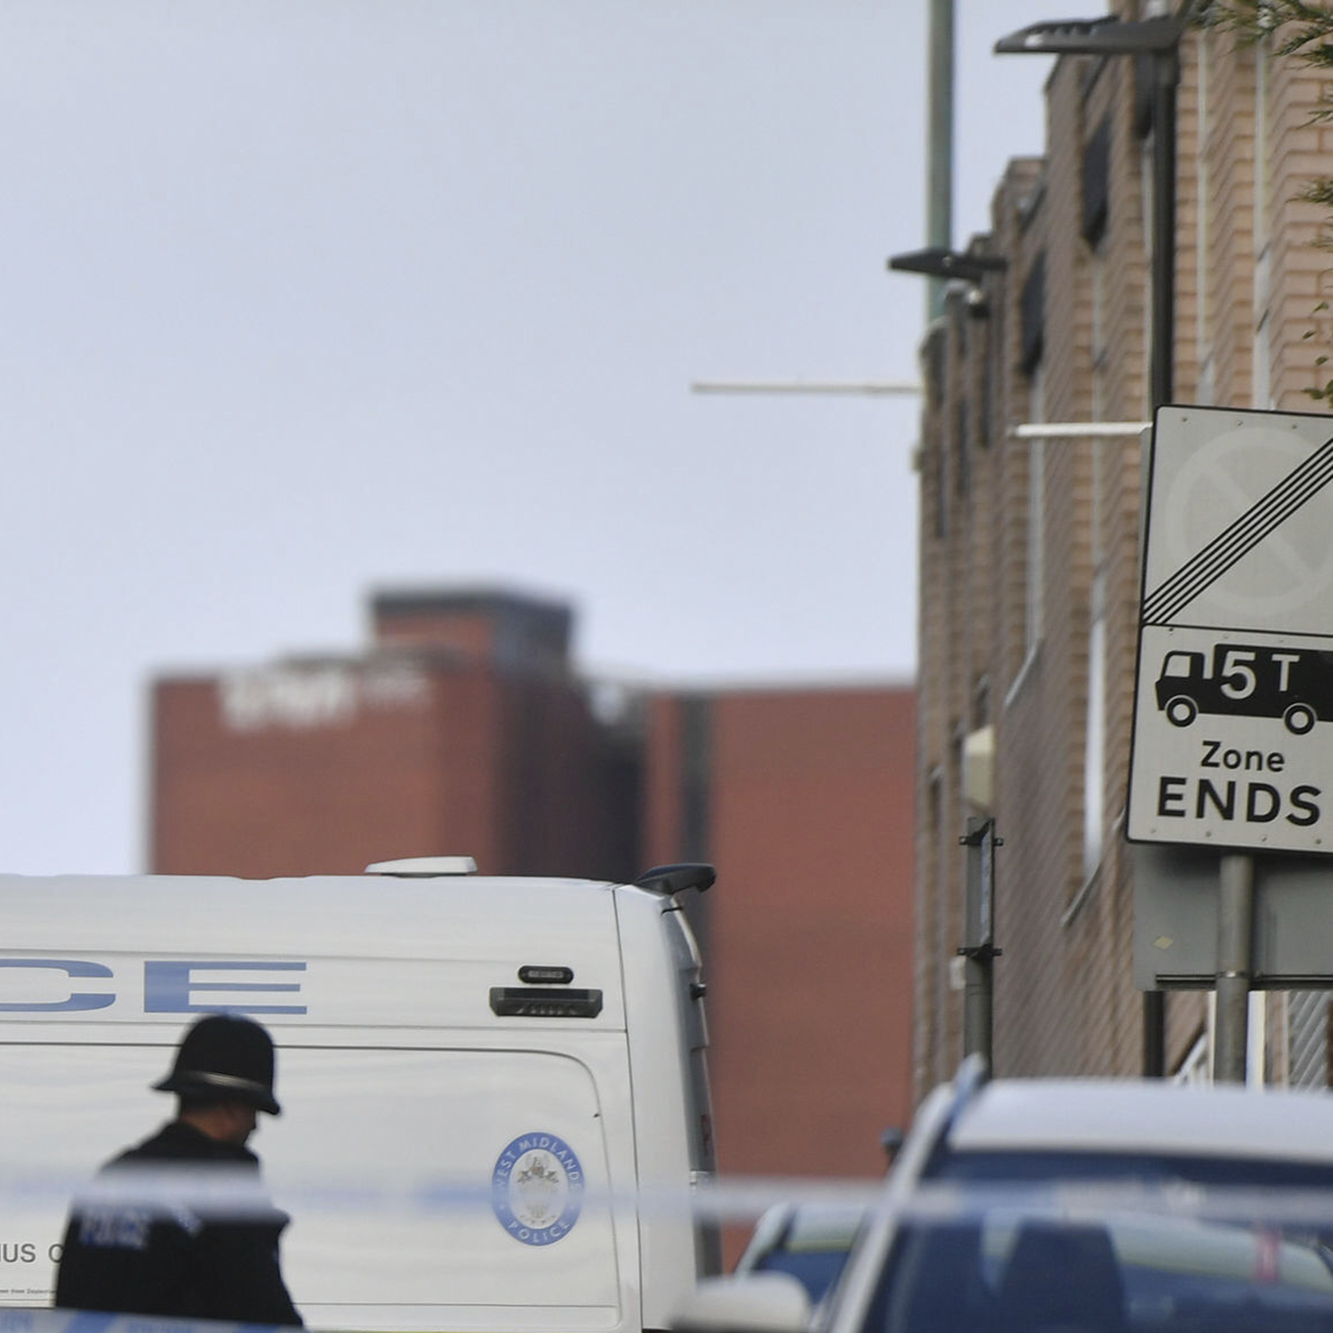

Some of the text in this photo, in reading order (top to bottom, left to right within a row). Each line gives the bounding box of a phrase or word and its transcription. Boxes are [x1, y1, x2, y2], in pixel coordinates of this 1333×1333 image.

[1200, 740, 1286, 773] Zone
[1157, 776, 1322, 827] ENDS
[507, 1219, 571, 1244] POLICE
